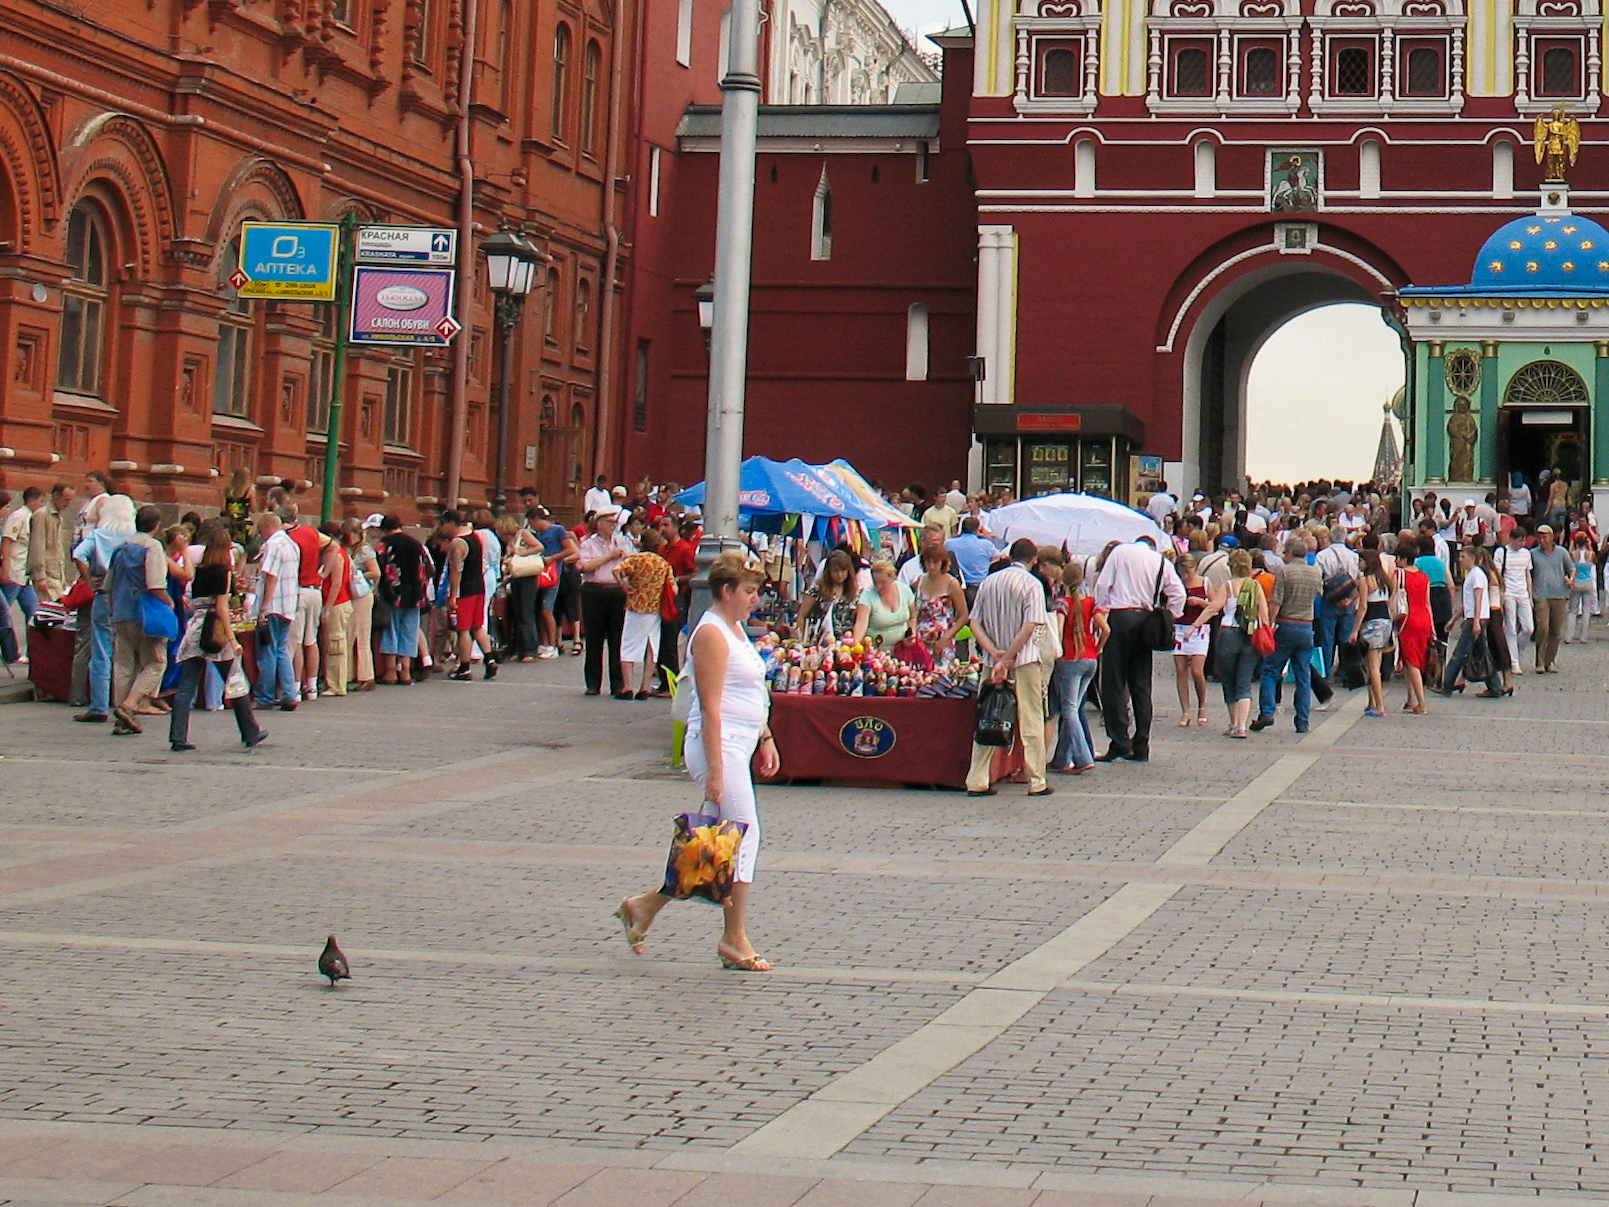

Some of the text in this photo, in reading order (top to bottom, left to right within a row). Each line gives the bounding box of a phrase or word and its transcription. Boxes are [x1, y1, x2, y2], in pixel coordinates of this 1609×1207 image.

[361, 231, 409, 241] КРАСНАЯ
[255, 262, 317, 275] АПТЕКА
[371, 317, 430, 330] САЛОН ОБУВИ
